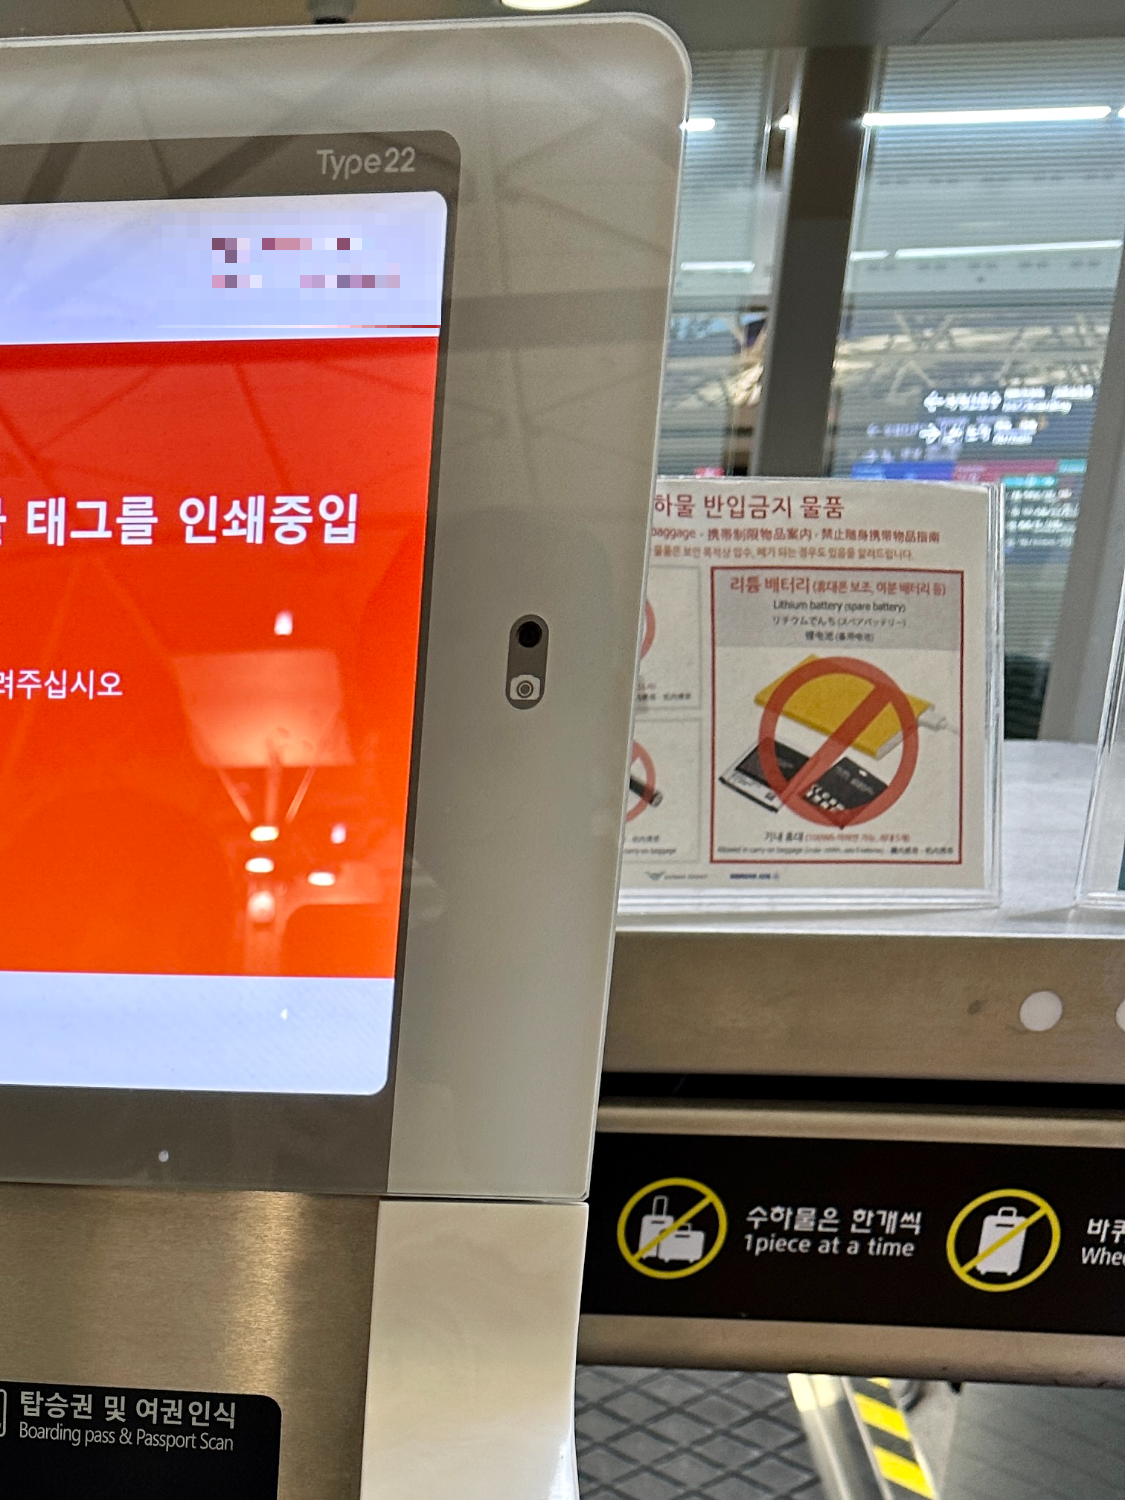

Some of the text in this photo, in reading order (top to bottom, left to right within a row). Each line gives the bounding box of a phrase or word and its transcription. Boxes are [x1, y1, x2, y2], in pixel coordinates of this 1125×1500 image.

[316, 146, 416, 181] Type22
[26, 495, 159, 548] 태그를
[178, 493, 360, 545] 인쇄중입
[653, 494, 845, 519] 하물 반입금지 물품
[730, 576, 762, 594] 리튬
[764, 576, 811, 595] 배터리
[773, 600, 905, 613] Lithium battery (spare battery)
[745, 1205, 923, 1236] 수하물은 한개씩
[817, 1236, 841, 1255] at
[846, 1241, 860, 1255] a
[867, 1236, 916, 1257] time
[1081, 1246, 1125, 1267] Whe
[20, 1390, 236, 1430] 탑승권 및 여권인식
[19, 1421, 234, 1452] Boarding pass & Passport Scan
